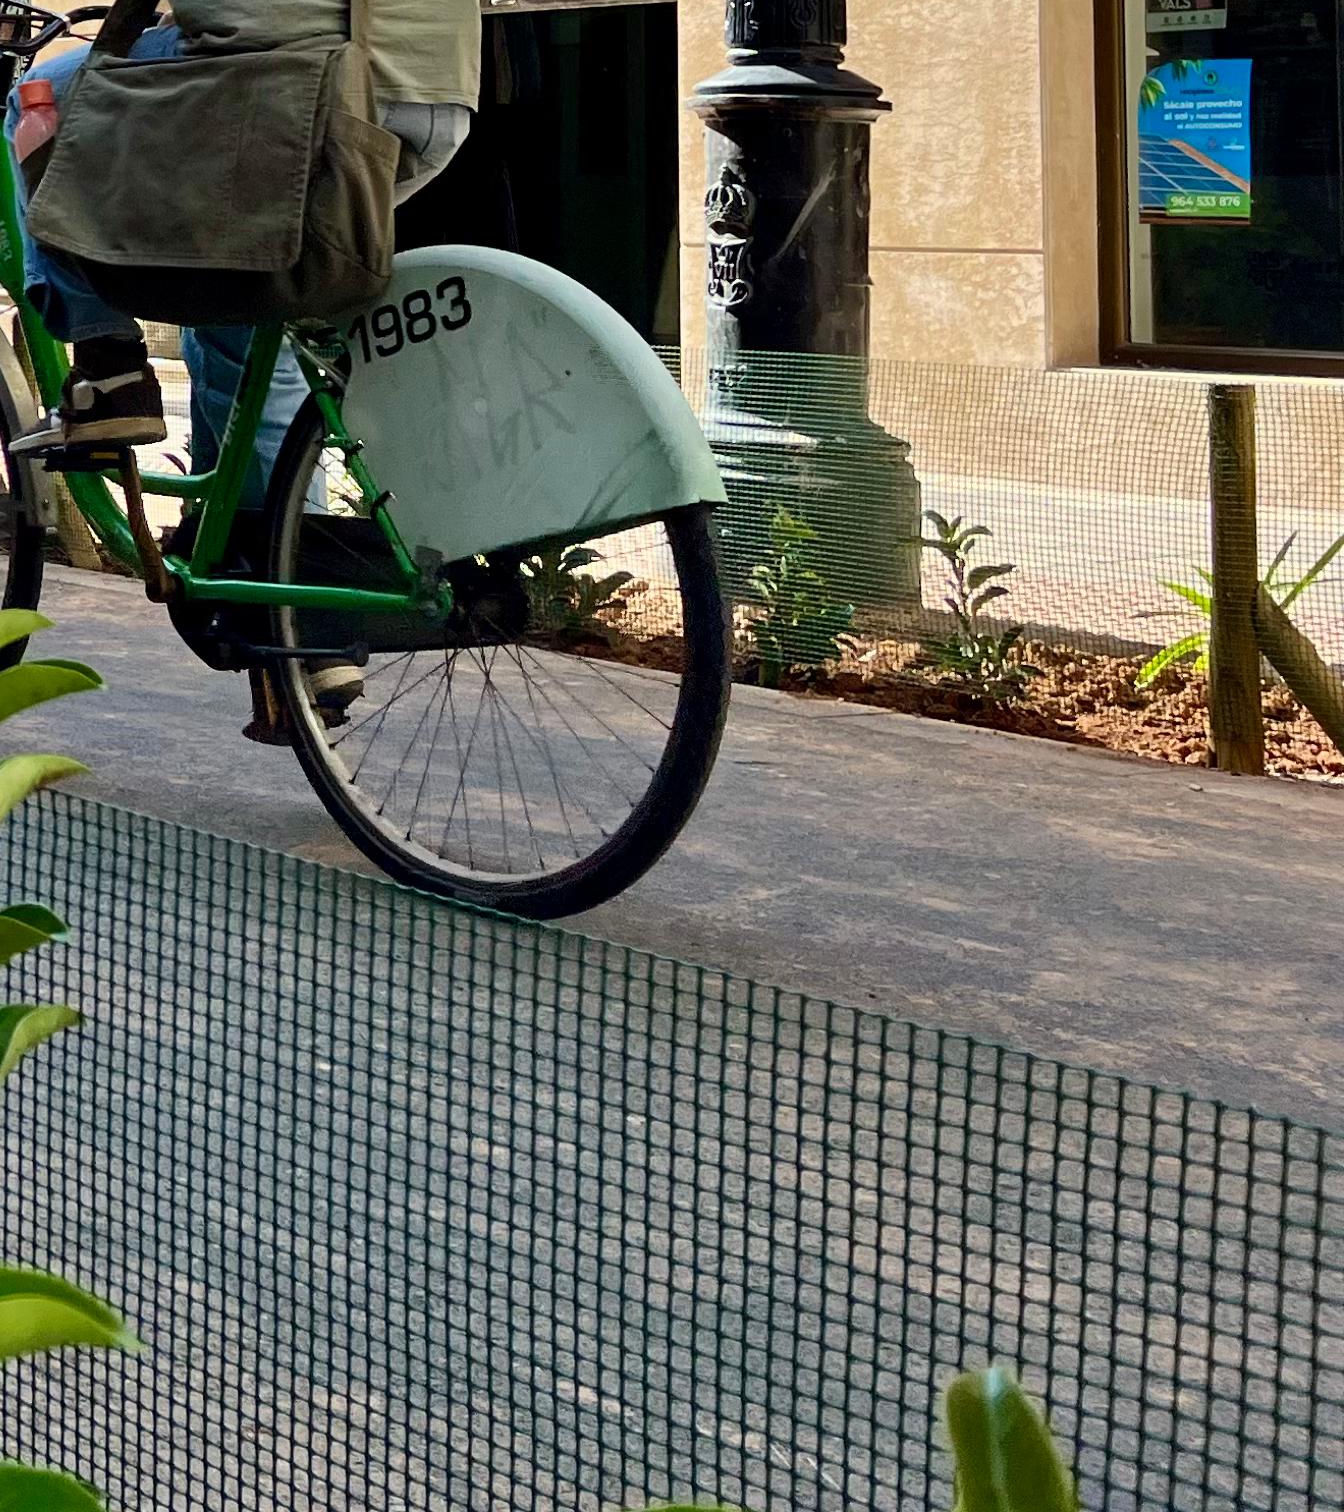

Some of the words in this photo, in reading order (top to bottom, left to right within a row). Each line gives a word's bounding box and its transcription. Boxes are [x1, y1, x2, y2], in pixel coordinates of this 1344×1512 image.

[1163, 100, 1195, 110] Sácale
[1196, 98, 1243, 110] provecho
[1171, 196, 1194, 207] 964
[1196, 196, 1217, 207] 533
[1219, 196, 1241, 207] 876
[348, 276, 472, 364] 1983
